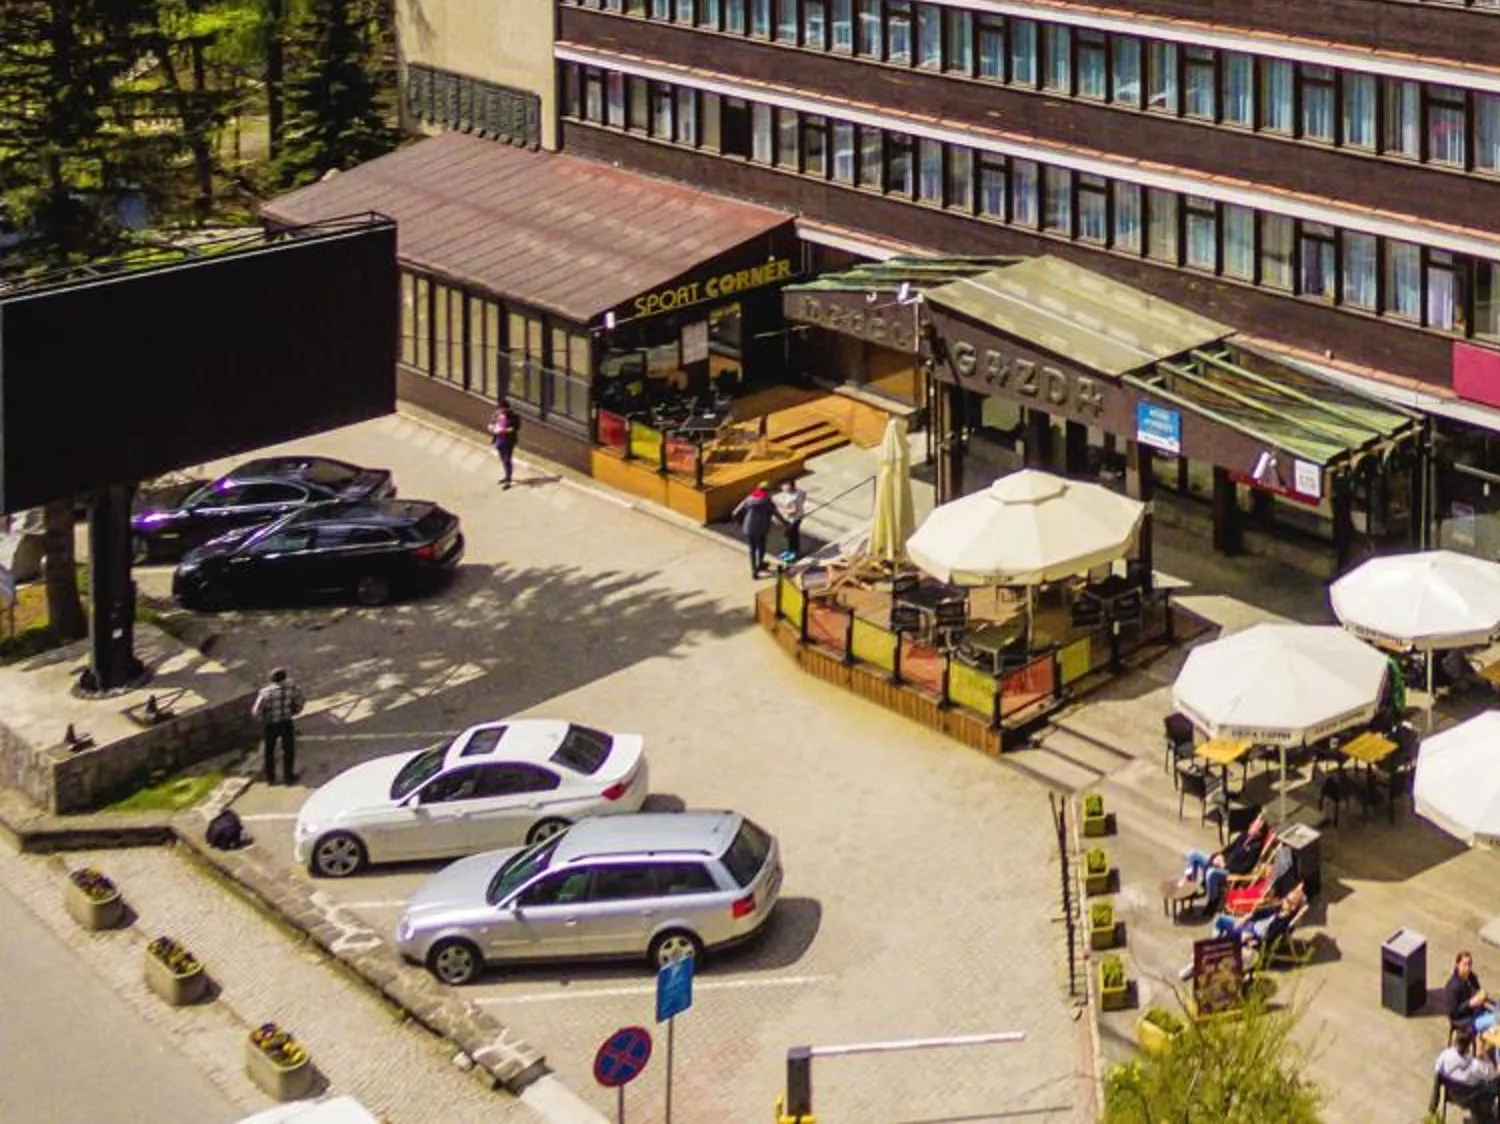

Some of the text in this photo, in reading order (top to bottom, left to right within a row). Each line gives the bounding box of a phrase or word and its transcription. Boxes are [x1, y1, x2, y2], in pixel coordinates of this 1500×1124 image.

[633, 259, 791, 317] SPORT CORNER
[952, 340, 1105, 417] GAZDA
